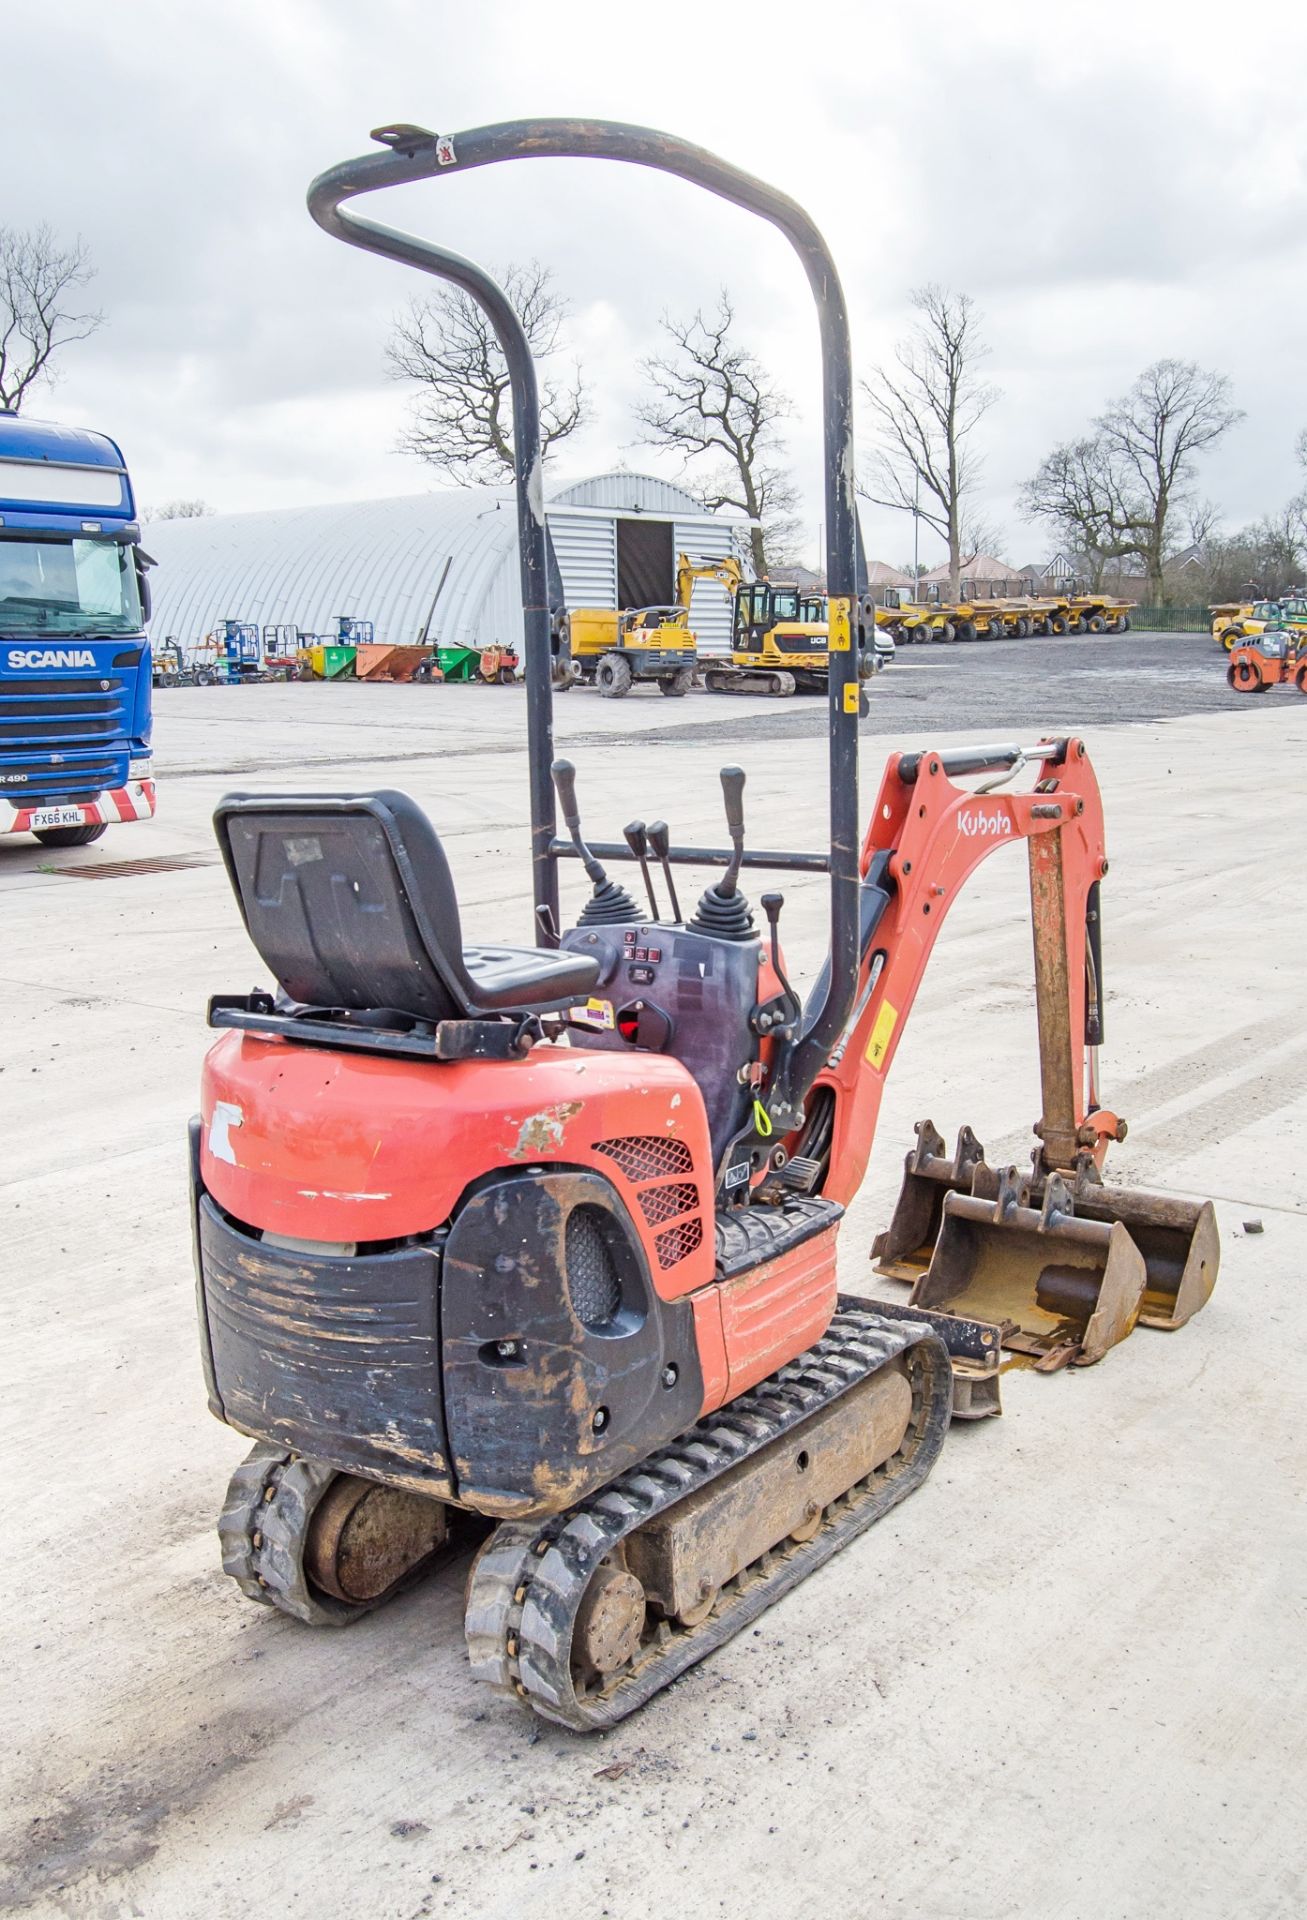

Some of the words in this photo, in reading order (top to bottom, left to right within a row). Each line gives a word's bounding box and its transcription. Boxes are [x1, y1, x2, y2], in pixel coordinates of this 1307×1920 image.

[7, 650, 96, 668] SCANIA
[7, 774, 28, 782] 490
[34, 813, 60, 826] FX66
[62, 811, 82, 823] KHL
[957, 810, 1012, 836] Kubota
